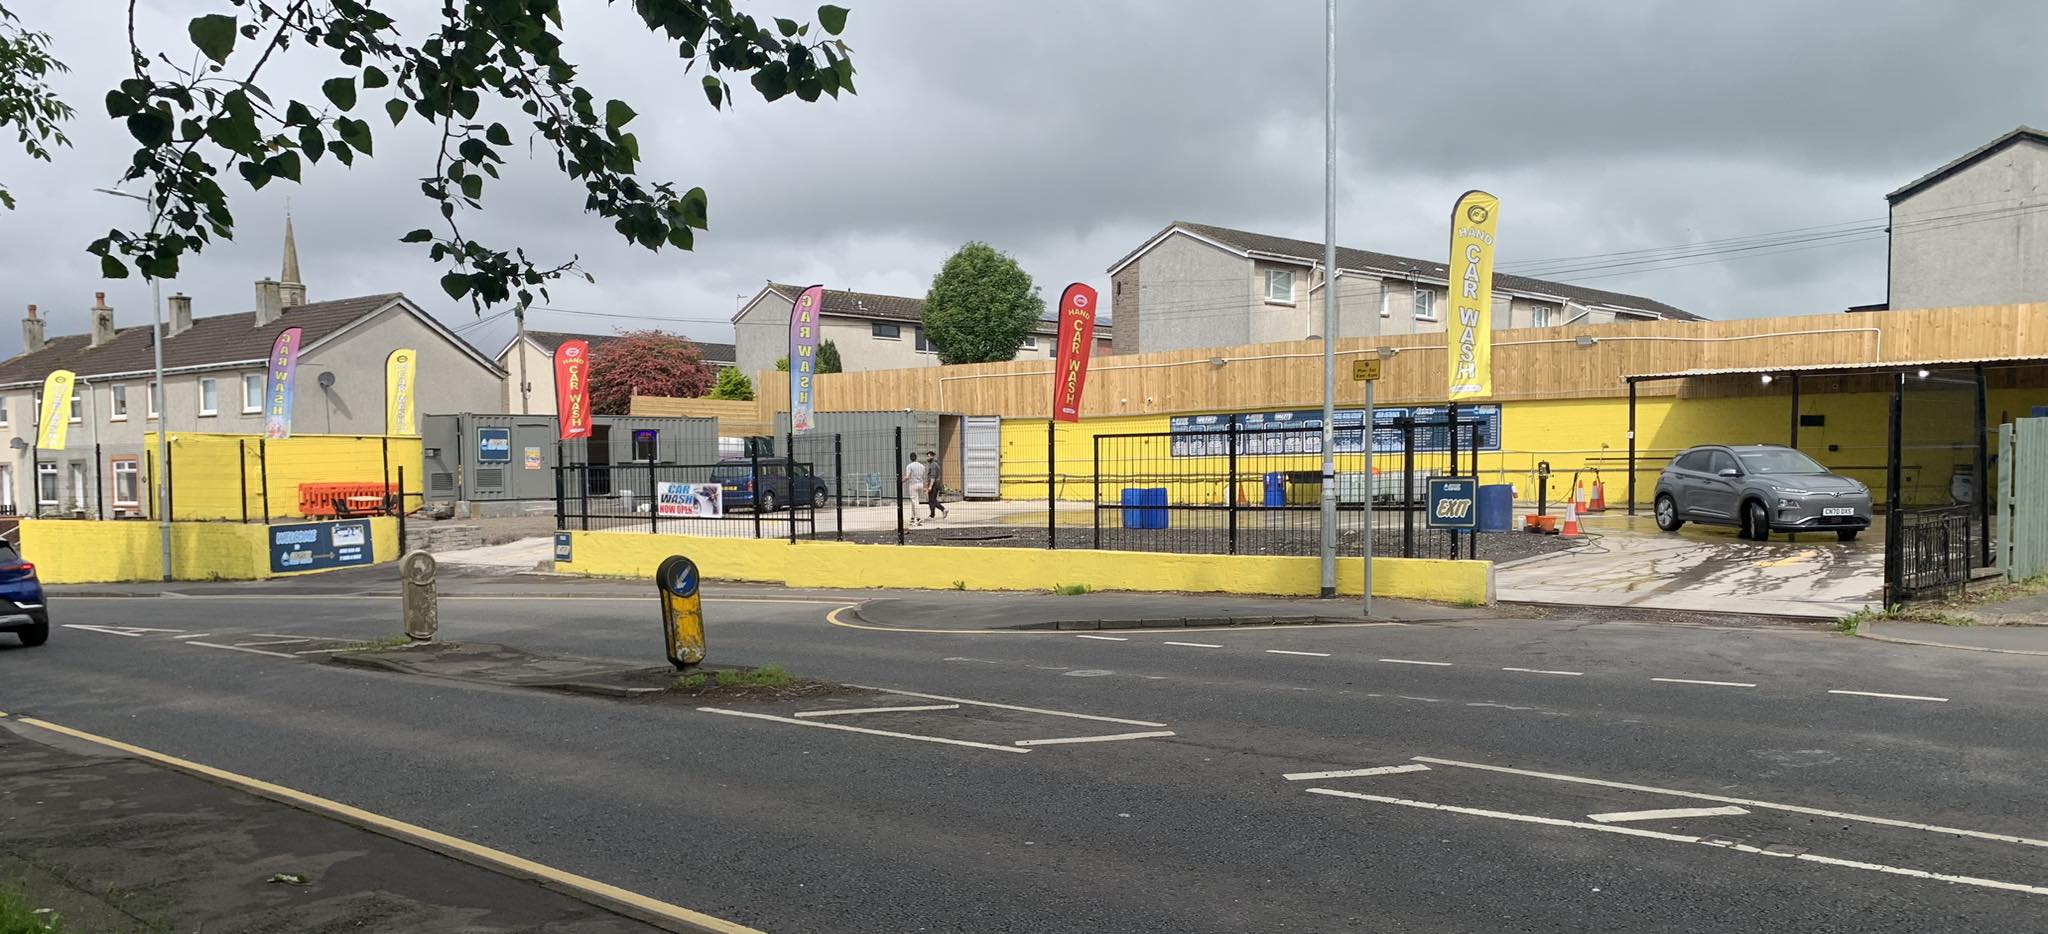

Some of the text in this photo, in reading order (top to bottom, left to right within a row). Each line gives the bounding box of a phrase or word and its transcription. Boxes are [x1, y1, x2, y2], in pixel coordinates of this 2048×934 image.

[1458, 226, 1494, 246] HAND
[1463, 244, 1481, 300] CAR
[1068, 308, 1091, 320] HAND
[1071, 319, 1083, 354] CAR
[1457, 306, 1480, 379] WASH
[562, 357, 585, 365] HAND
[569, 365, 579, 390] CAR
[1066, 359, 1081, 404] WASH
[569, 394, 582, 426] WASH
[661, 494, 693, 505] WASH
[668, 485, 691, 495] CAR
[660, 504, 693, 515] NOW OPEN
[1437, 499, 1471, 518] EXIT
[276, 529, 317, 545] WELCOME
